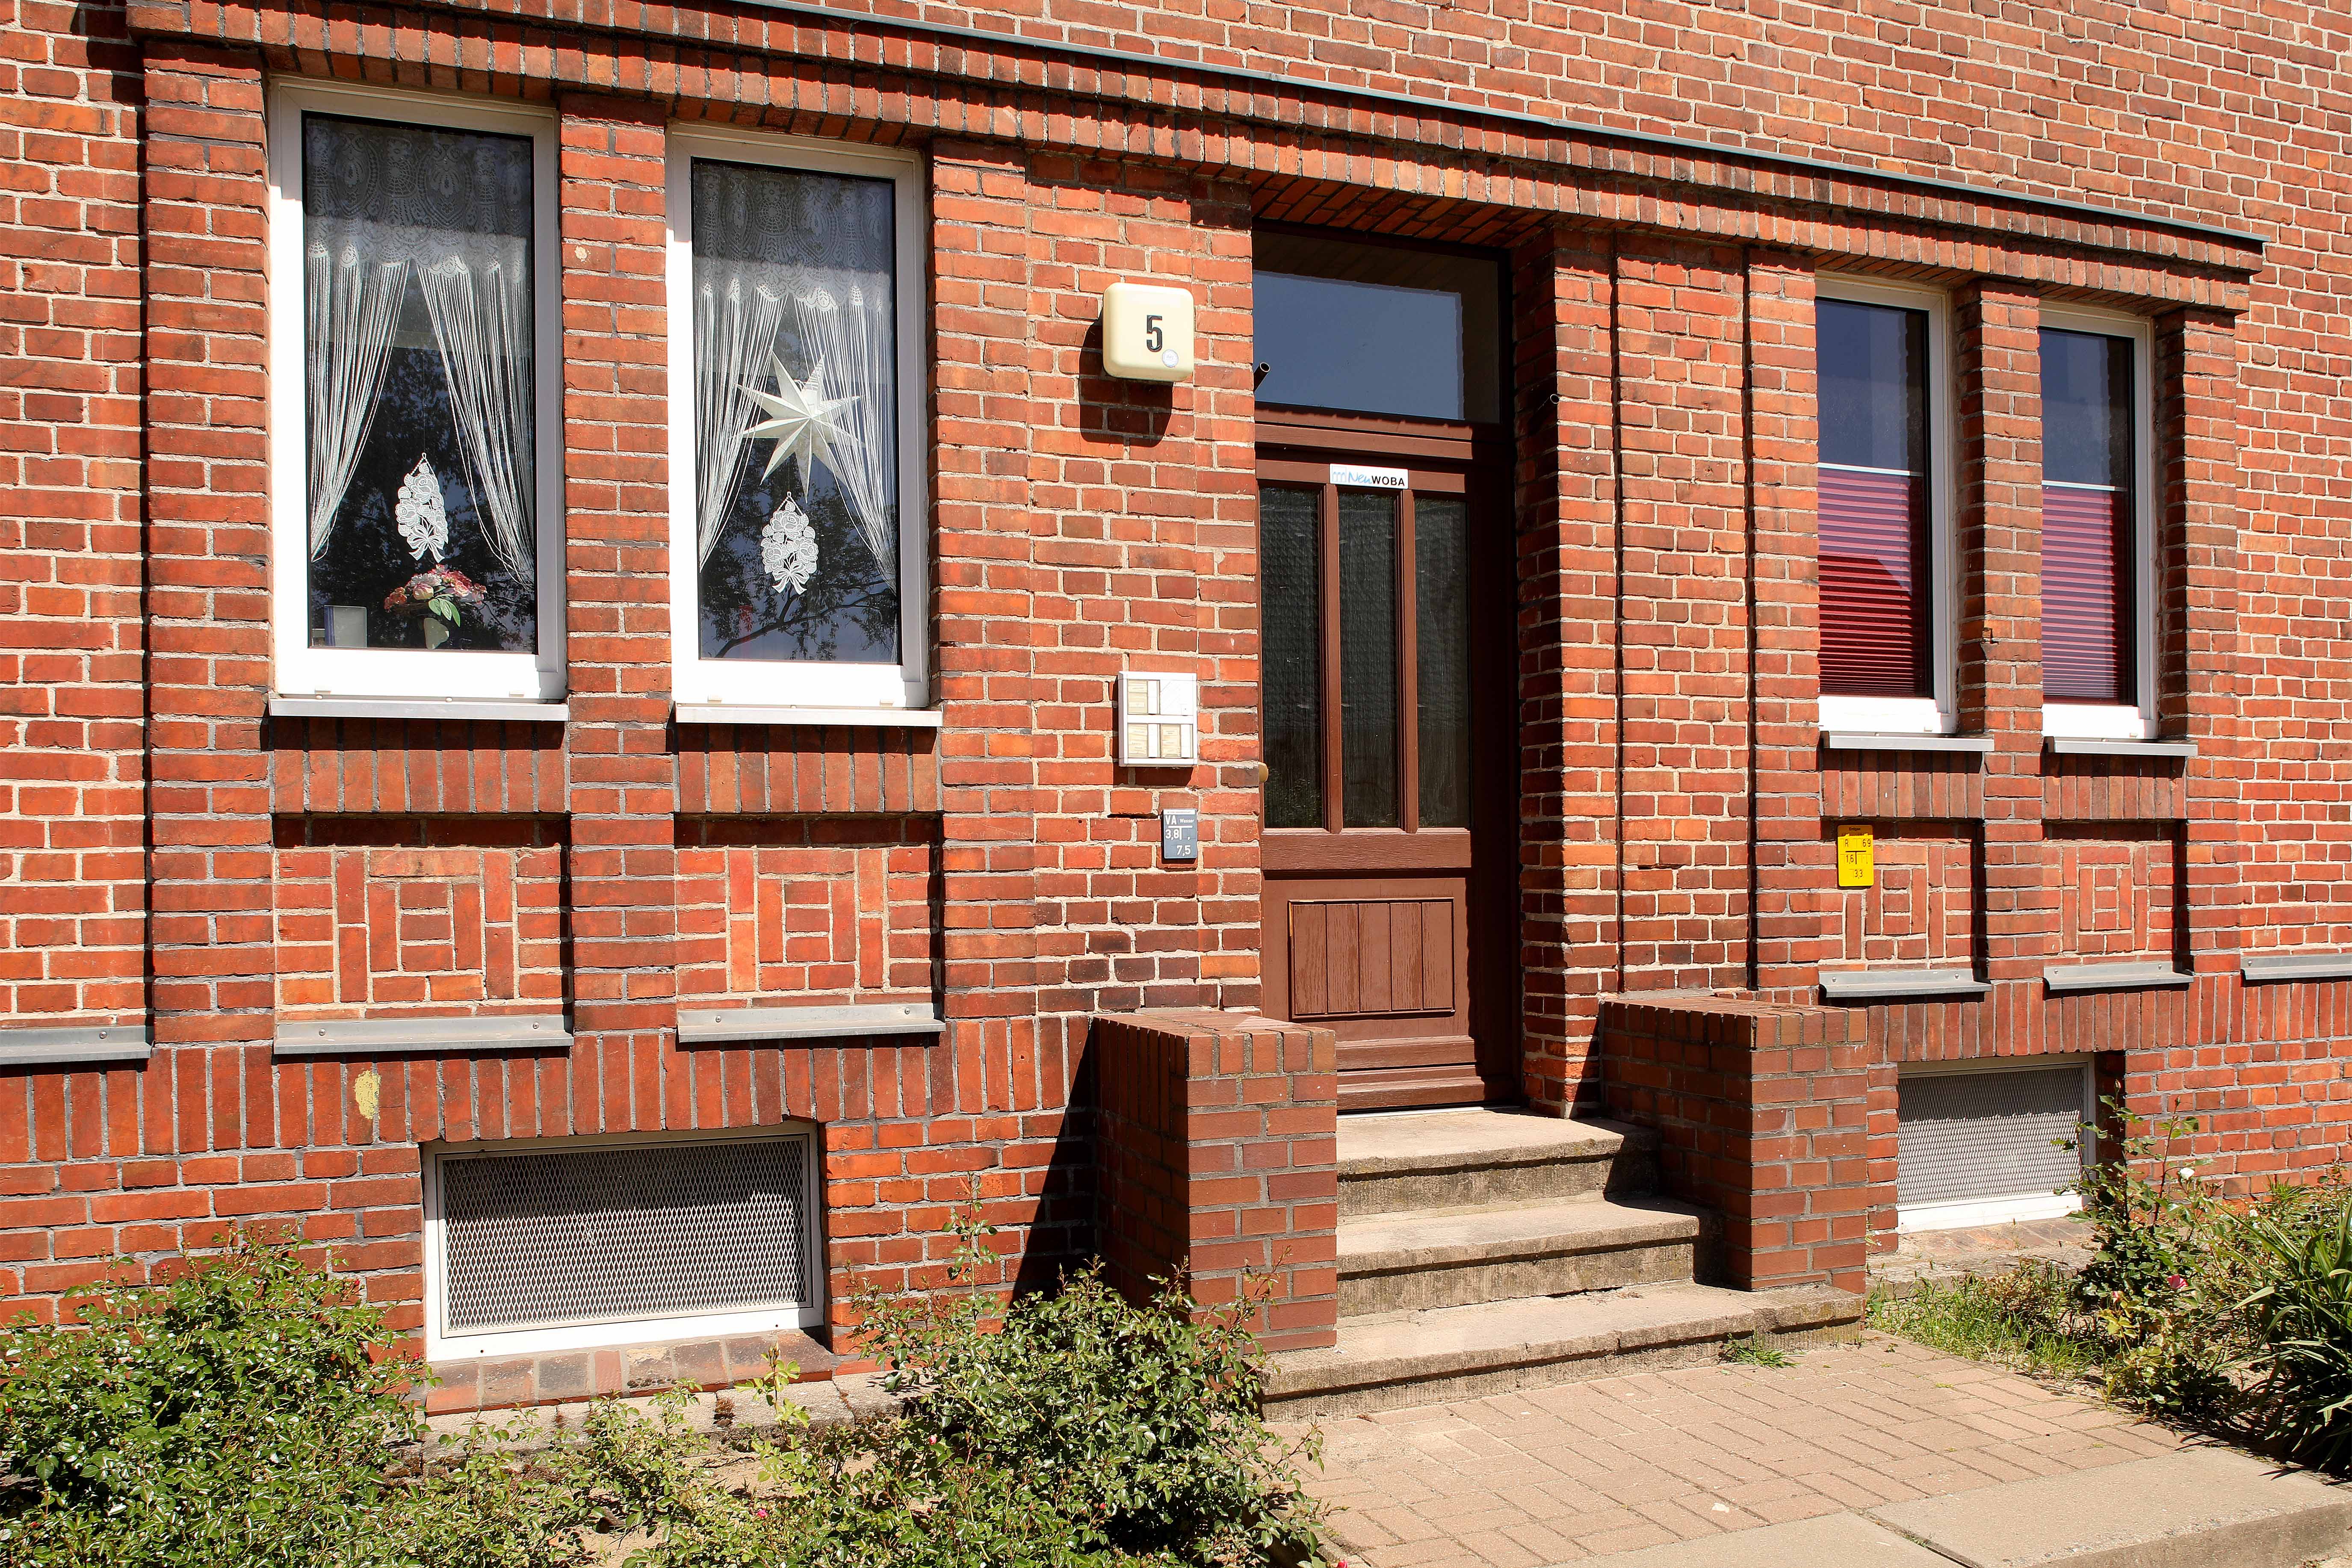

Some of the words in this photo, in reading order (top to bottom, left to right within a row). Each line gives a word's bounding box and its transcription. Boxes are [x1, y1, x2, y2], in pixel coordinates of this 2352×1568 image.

[1146, 315, 1162, 352] 5
[1348, 472, 1405, 486] NeuWOBA
[1165, 815, 1177, 825] VA
[1862, 839, 1871, 847] 69
[1176, 845, 1191, 857] 7,5
